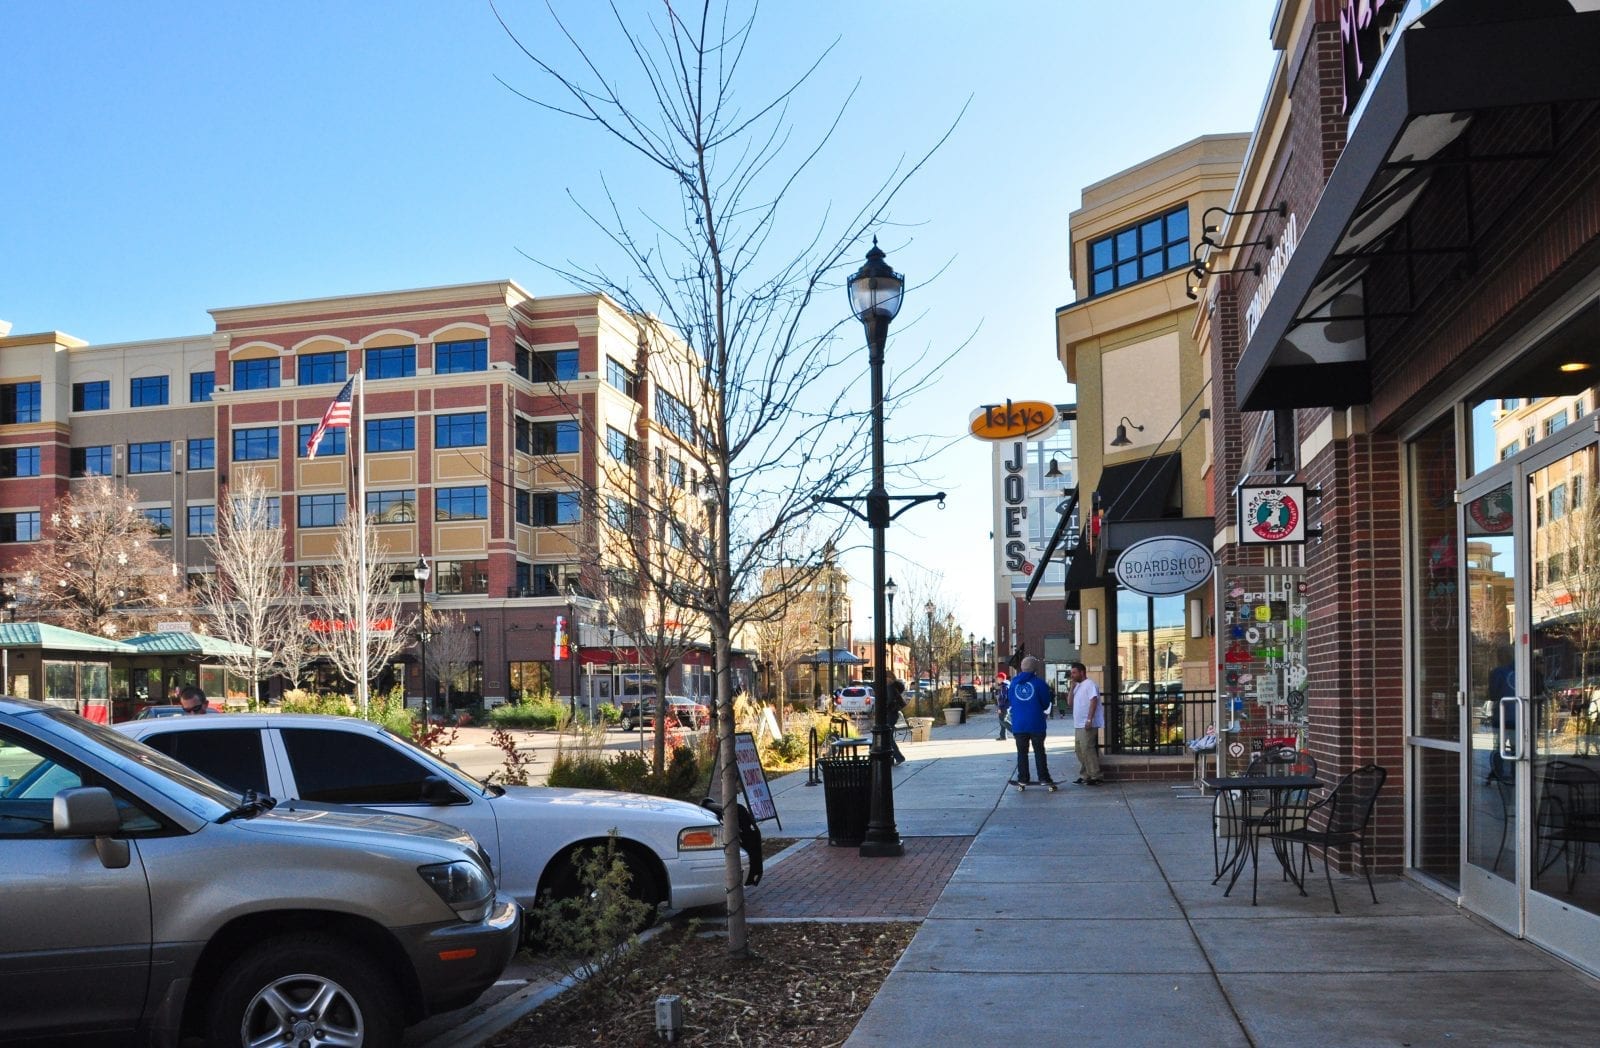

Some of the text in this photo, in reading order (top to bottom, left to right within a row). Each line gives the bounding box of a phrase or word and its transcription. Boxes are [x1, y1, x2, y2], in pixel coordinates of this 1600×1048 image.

[981, 398, 1044, 433] Tokyo
[1004, 441, 1028, 572] JOE'S
[1125, 557, 1205, 574] BOARDSHOP
